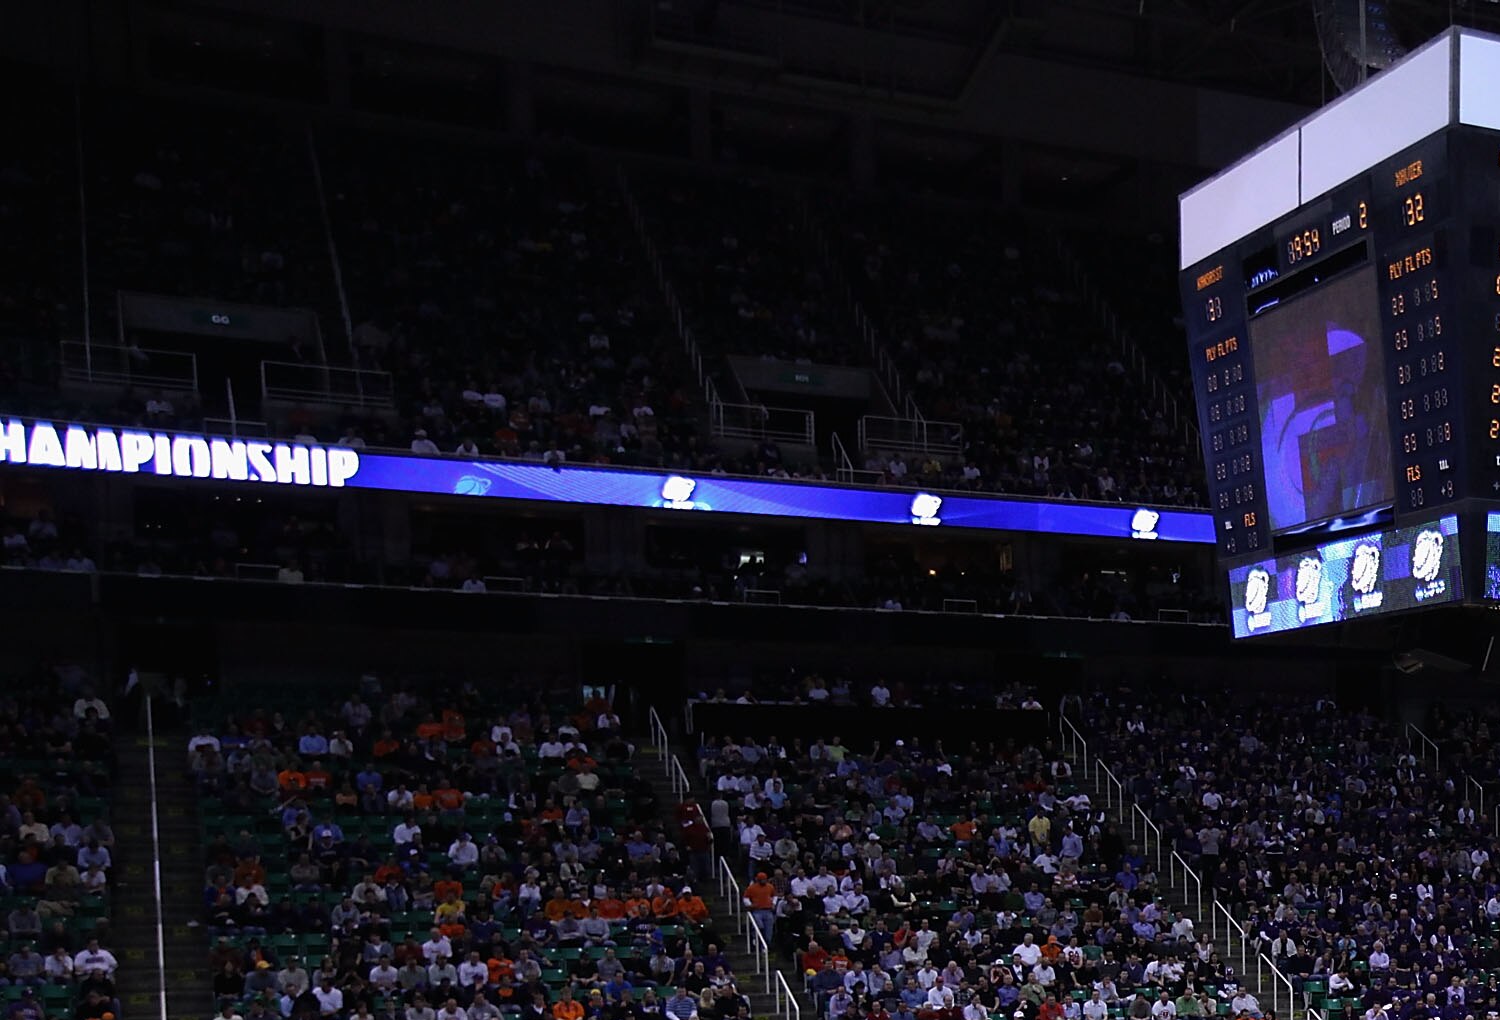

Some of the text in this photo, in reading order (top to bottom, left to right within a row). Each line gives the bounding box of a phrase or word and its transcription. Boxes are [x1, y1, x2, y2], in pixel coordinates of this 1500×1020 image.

[1332, 215, 1350, 235] PERIOD
[1359, 202, 1367, 229] 2
[1406, 193, 1424, 226] 32
